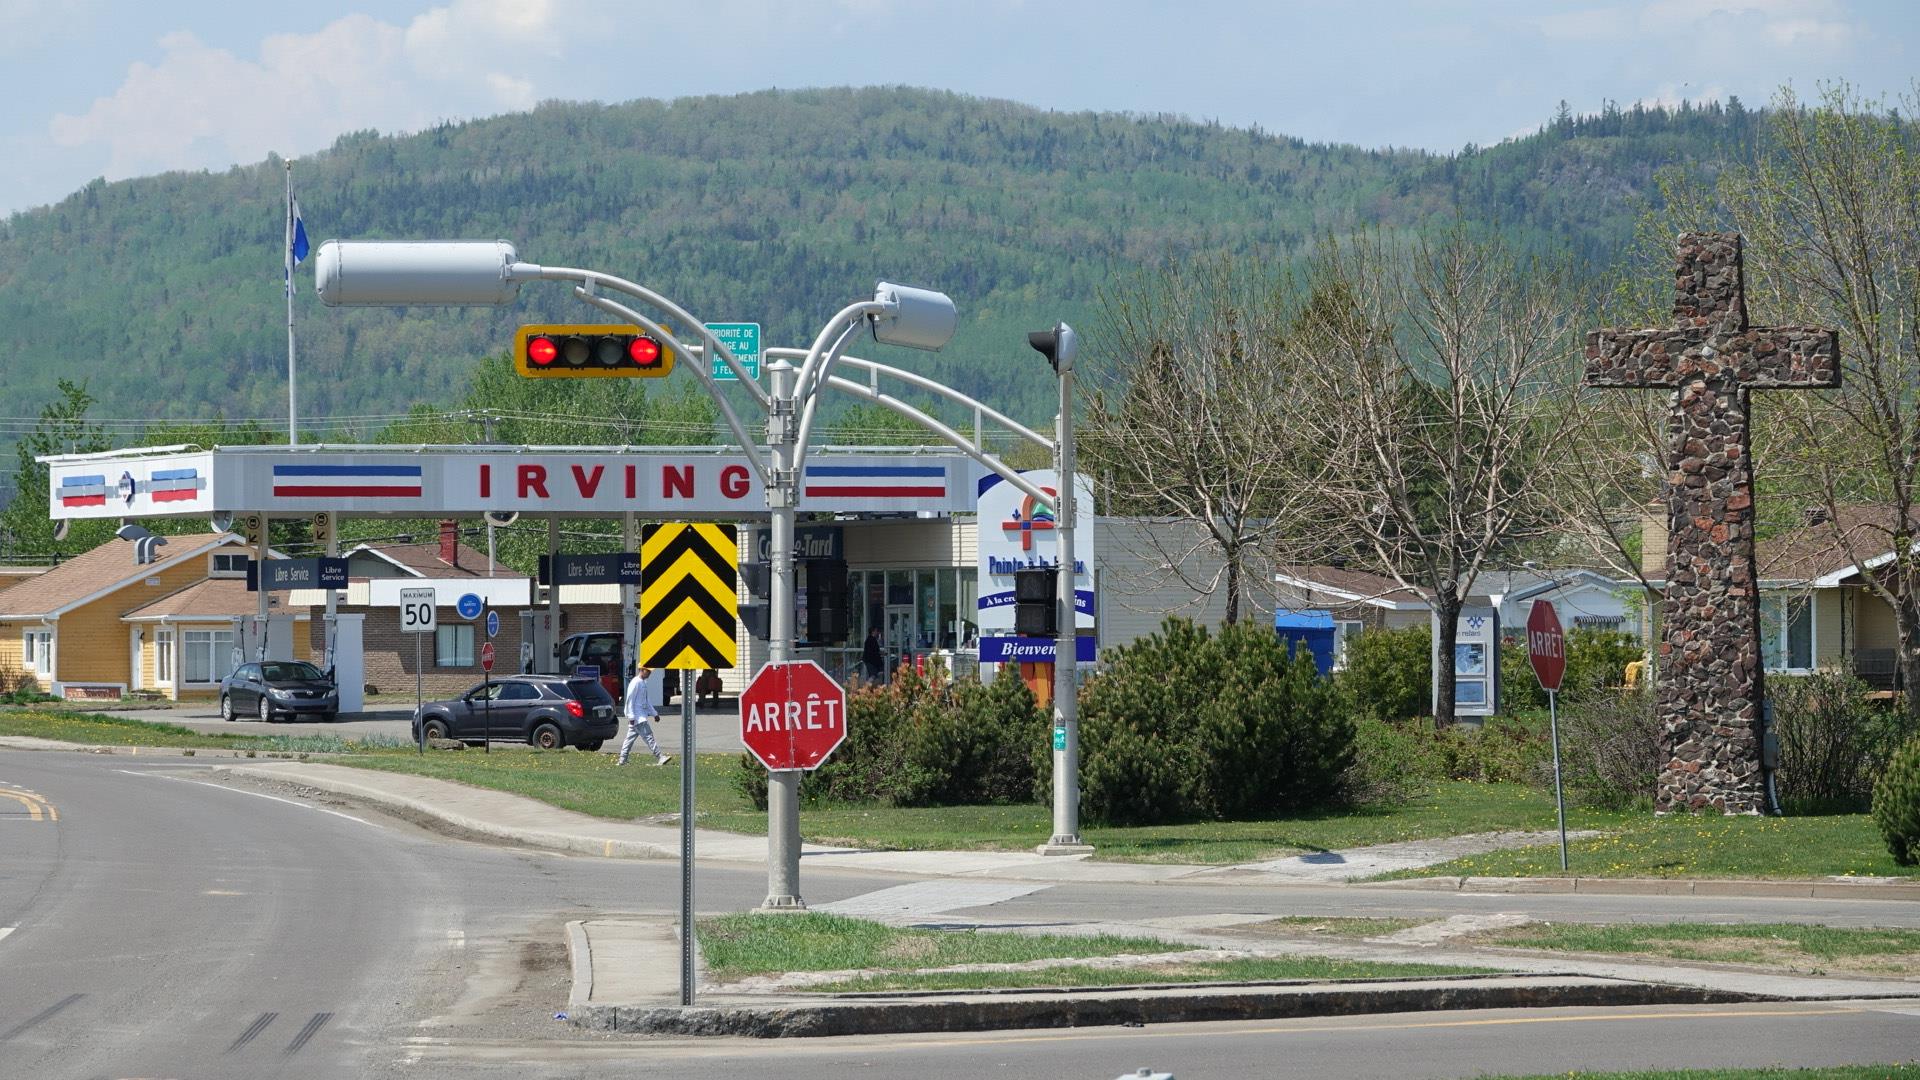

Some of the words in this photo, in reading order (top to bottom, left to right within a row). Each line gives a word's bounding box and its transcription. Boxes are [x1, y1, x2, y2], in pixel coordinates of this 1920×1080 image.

[744, 329, 753, 338] DE
[739, 341, 749, 350] AU
[479, 464, 750, 499] IRVING
[758, 533, 834, 560] Coe-Tard
[325, 566, 342, 574] Libre
[567, 561, 583, 577] Libre
[584, 561, 606, 577] Service
[623, 561, 641, 569] Libre
[275, 567, 288, 581] Libre
[290, 566, 309, 581] Service
[994, 596, 1003, 604] la
[405, 603, 432, 626] 50
[1001, 642, 1057, 656] Bienven
[1530, 627, 1563, 659] ARRÊT
[746, 693, 839, 733] ARRÊT
